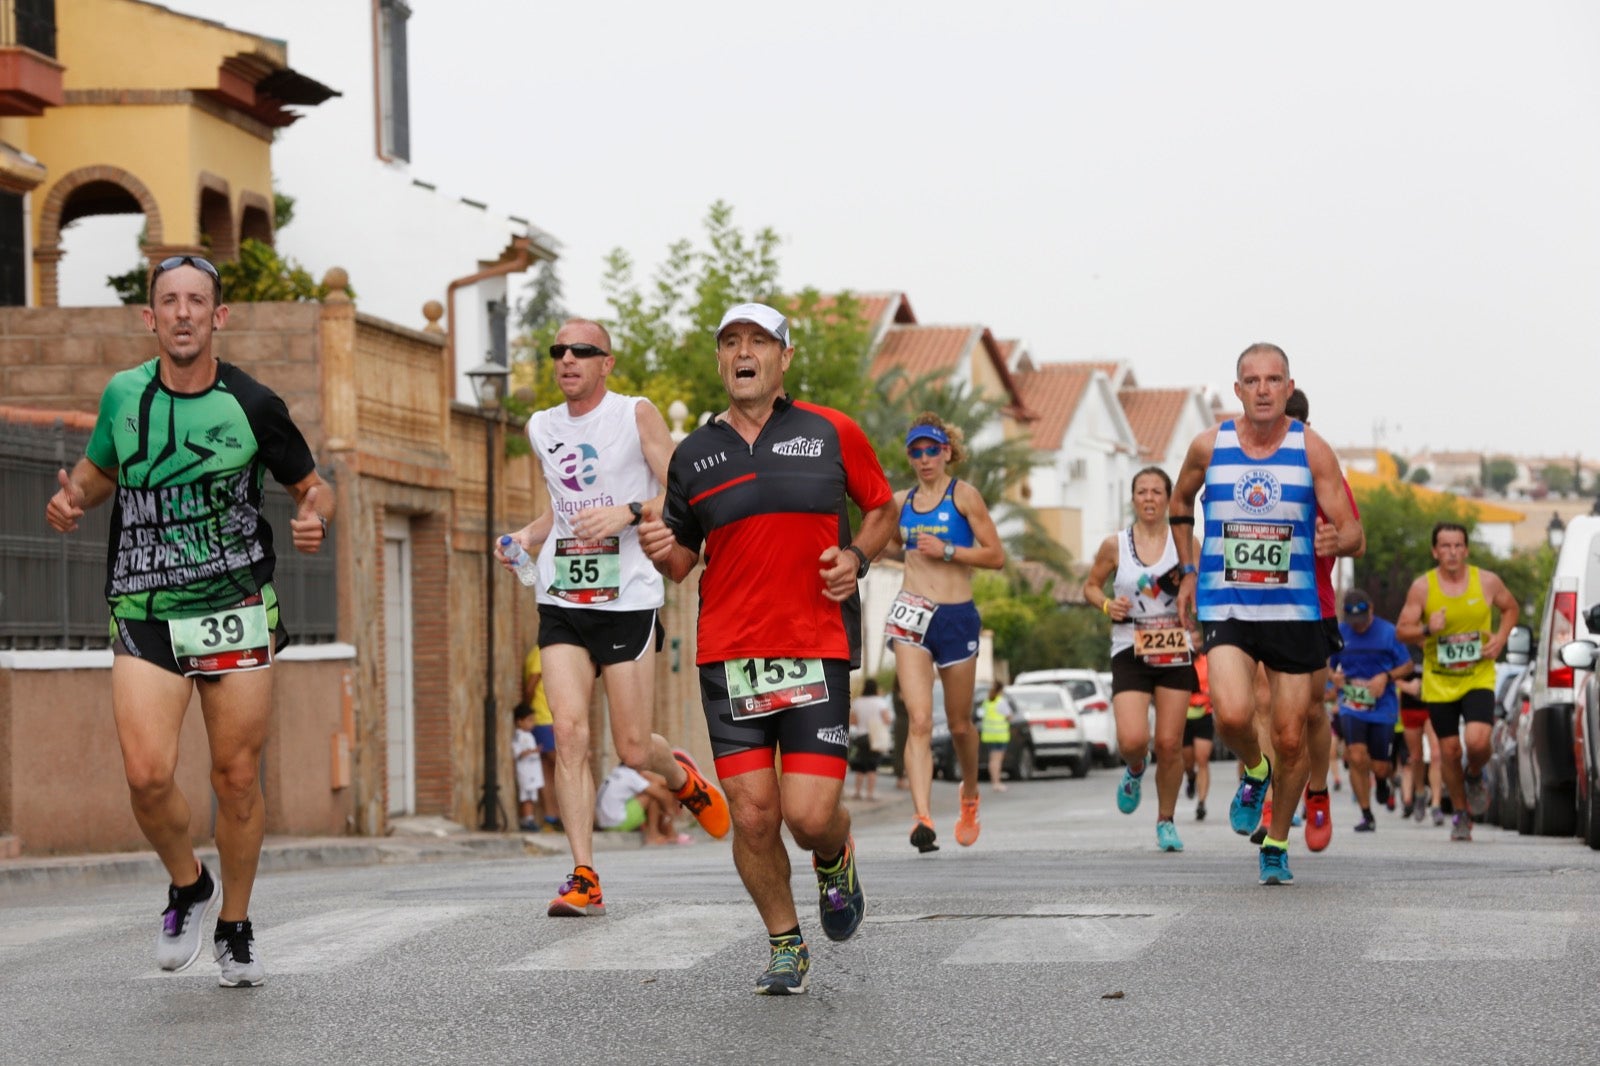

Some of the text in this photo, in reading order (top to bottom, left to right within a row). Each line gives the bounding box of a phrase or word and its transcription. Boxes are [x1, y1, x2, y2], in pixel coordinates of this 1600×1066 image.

[693, 451, 728, 473] GOBIK
[136, 527, 158, 547] DE
[1234, 542, 1282, 566] 646
[569, 559, 599, 584] 55
[200, 614, 245, 648] 39
[1143, 632, 1185, 649] 2242
[1446, 643, 1476, 660] 679
[742, 658, 808, 689] 153
